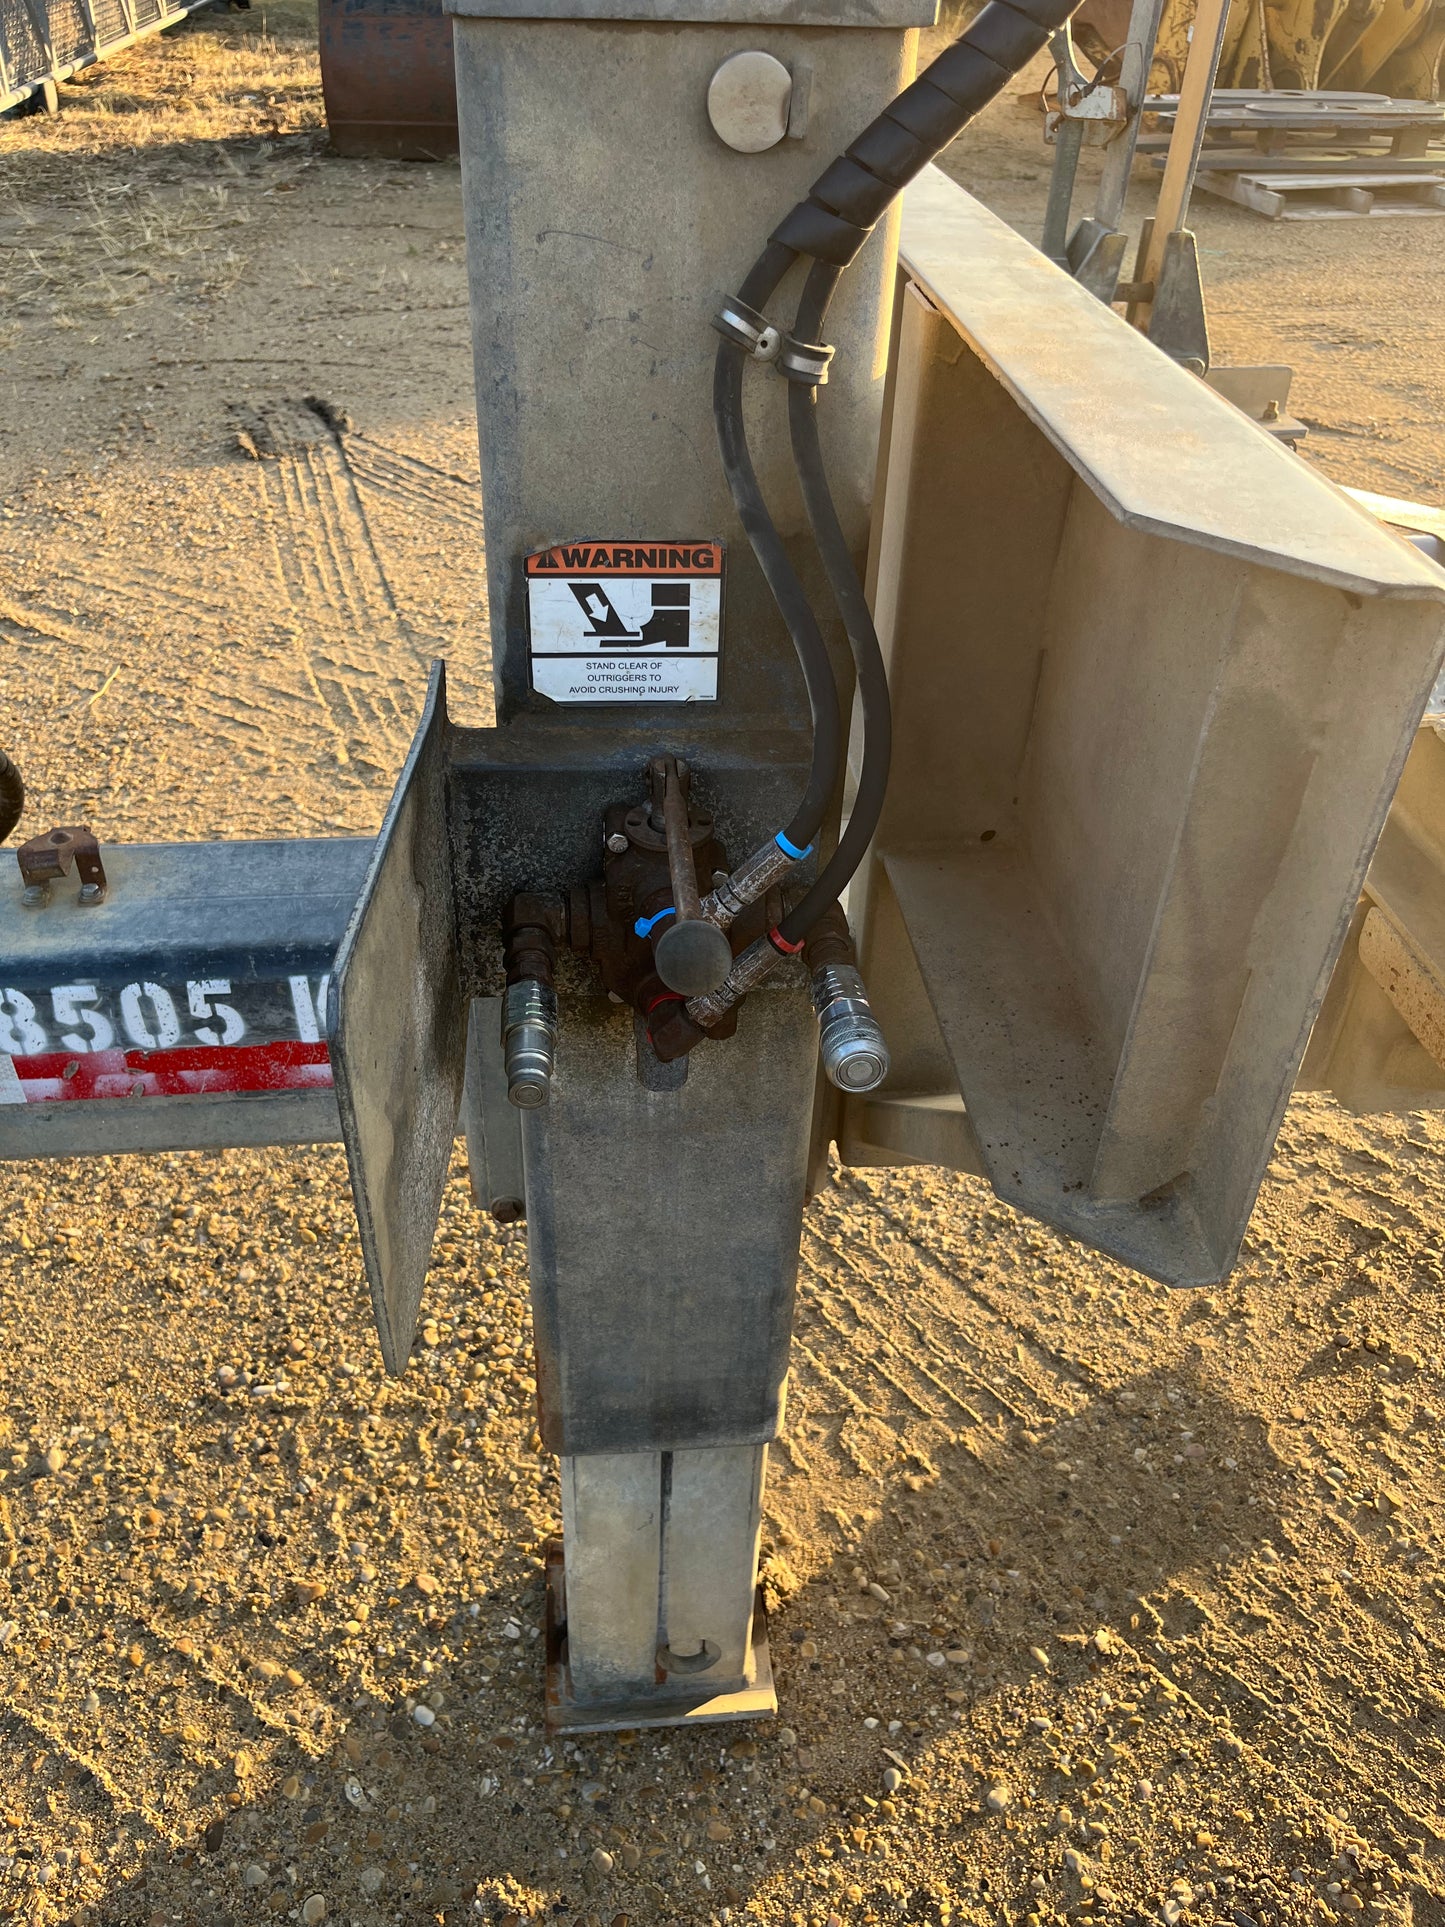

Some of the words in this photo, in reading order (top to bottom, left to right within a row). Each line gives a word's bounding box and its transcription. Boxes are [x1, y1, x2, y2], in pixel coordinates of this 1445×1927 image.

[561, 548, 714, 569] WARNING
[586, 662, 616, 670] STAND
[618, 662, 648, 670] CLEAR
[650, 662, 663, 670] OF
[587, 674, 647, 682] OUTRIGGERS
[649, 674, 662, 682] TO
[569, 686, 597, 694] AVOID
[598, 686, 646, 694] CRUSHING
[647, 686, 680, 694] INJURY
[0, 979, 247, 1056] 8505
